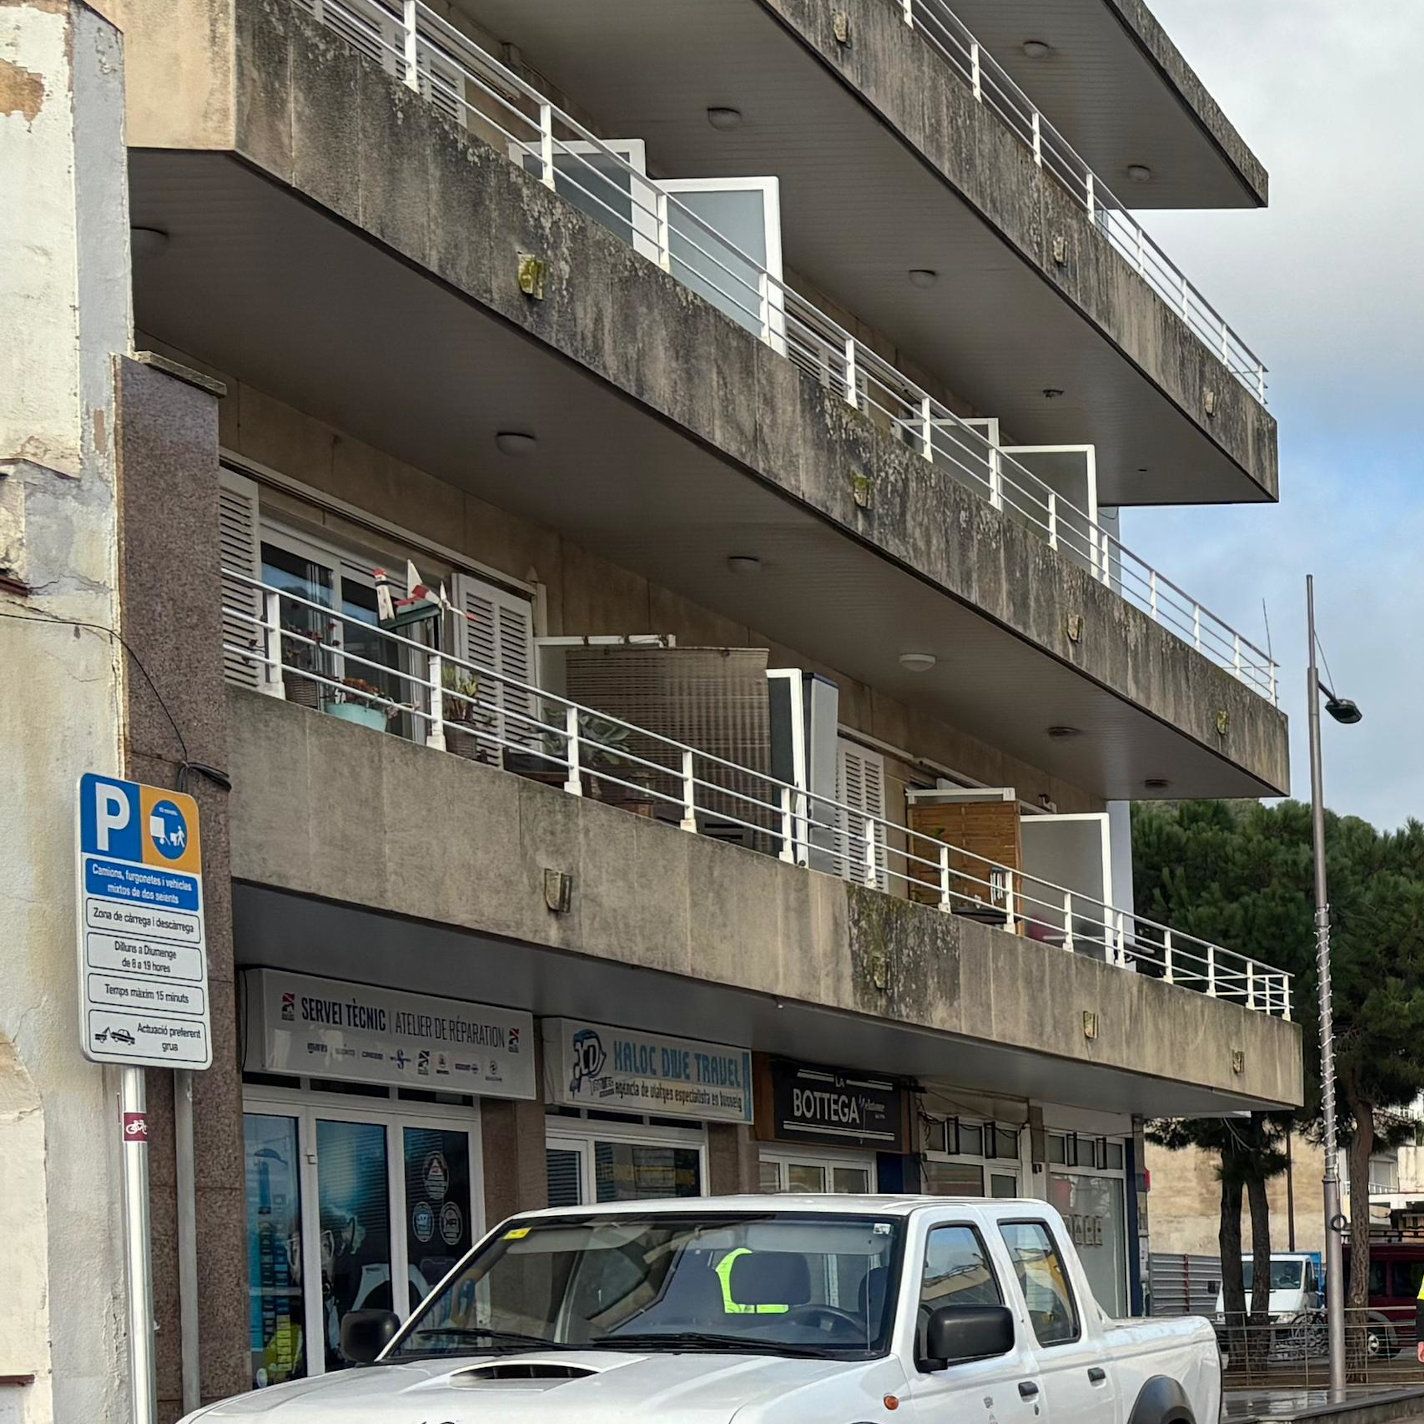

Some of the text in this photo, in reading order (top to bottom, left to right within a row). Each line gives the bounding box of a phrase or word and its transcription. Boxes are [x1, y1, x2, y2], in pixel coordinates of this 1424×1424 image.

[95, 782, 130, 851] P
[92, 864, 125, 880] Camions,
[125, 869, 161, 886] furgonetes
[107, 883, 131, 895] mixtos
[131, 887, 140, 897] de
[141, 889, 155, 900] dos
[93, 907, 112, 920] Zona
[113, 910, 123, 922] de
[114, 941, 137, 954] Dilluns
[144, 945, 177, 961] Diumenge
[122, 958, 131, 967] de
[143, 960, 151, 970] 19
[152, 962, 171, 973] hores
[104, 983, 129, 997] Temps
[156, 990, 164, 1000] 15
[165, 991, 189, 1003] minuts
[301, 997, 386, 1031] SERVEI TÈCNIC
[137, 1022, 201, 1039] Actuació preferent
[395, 1012, 505, 1048] ATELIER DE RÉPARATION
[162, 1042, 178, 1052] grua
[695, 1053, 742, 1087] TRAVEL
[835, 1075, 845, 1088] LA
[793, 1088, 860, 1123] BOTTEGA
